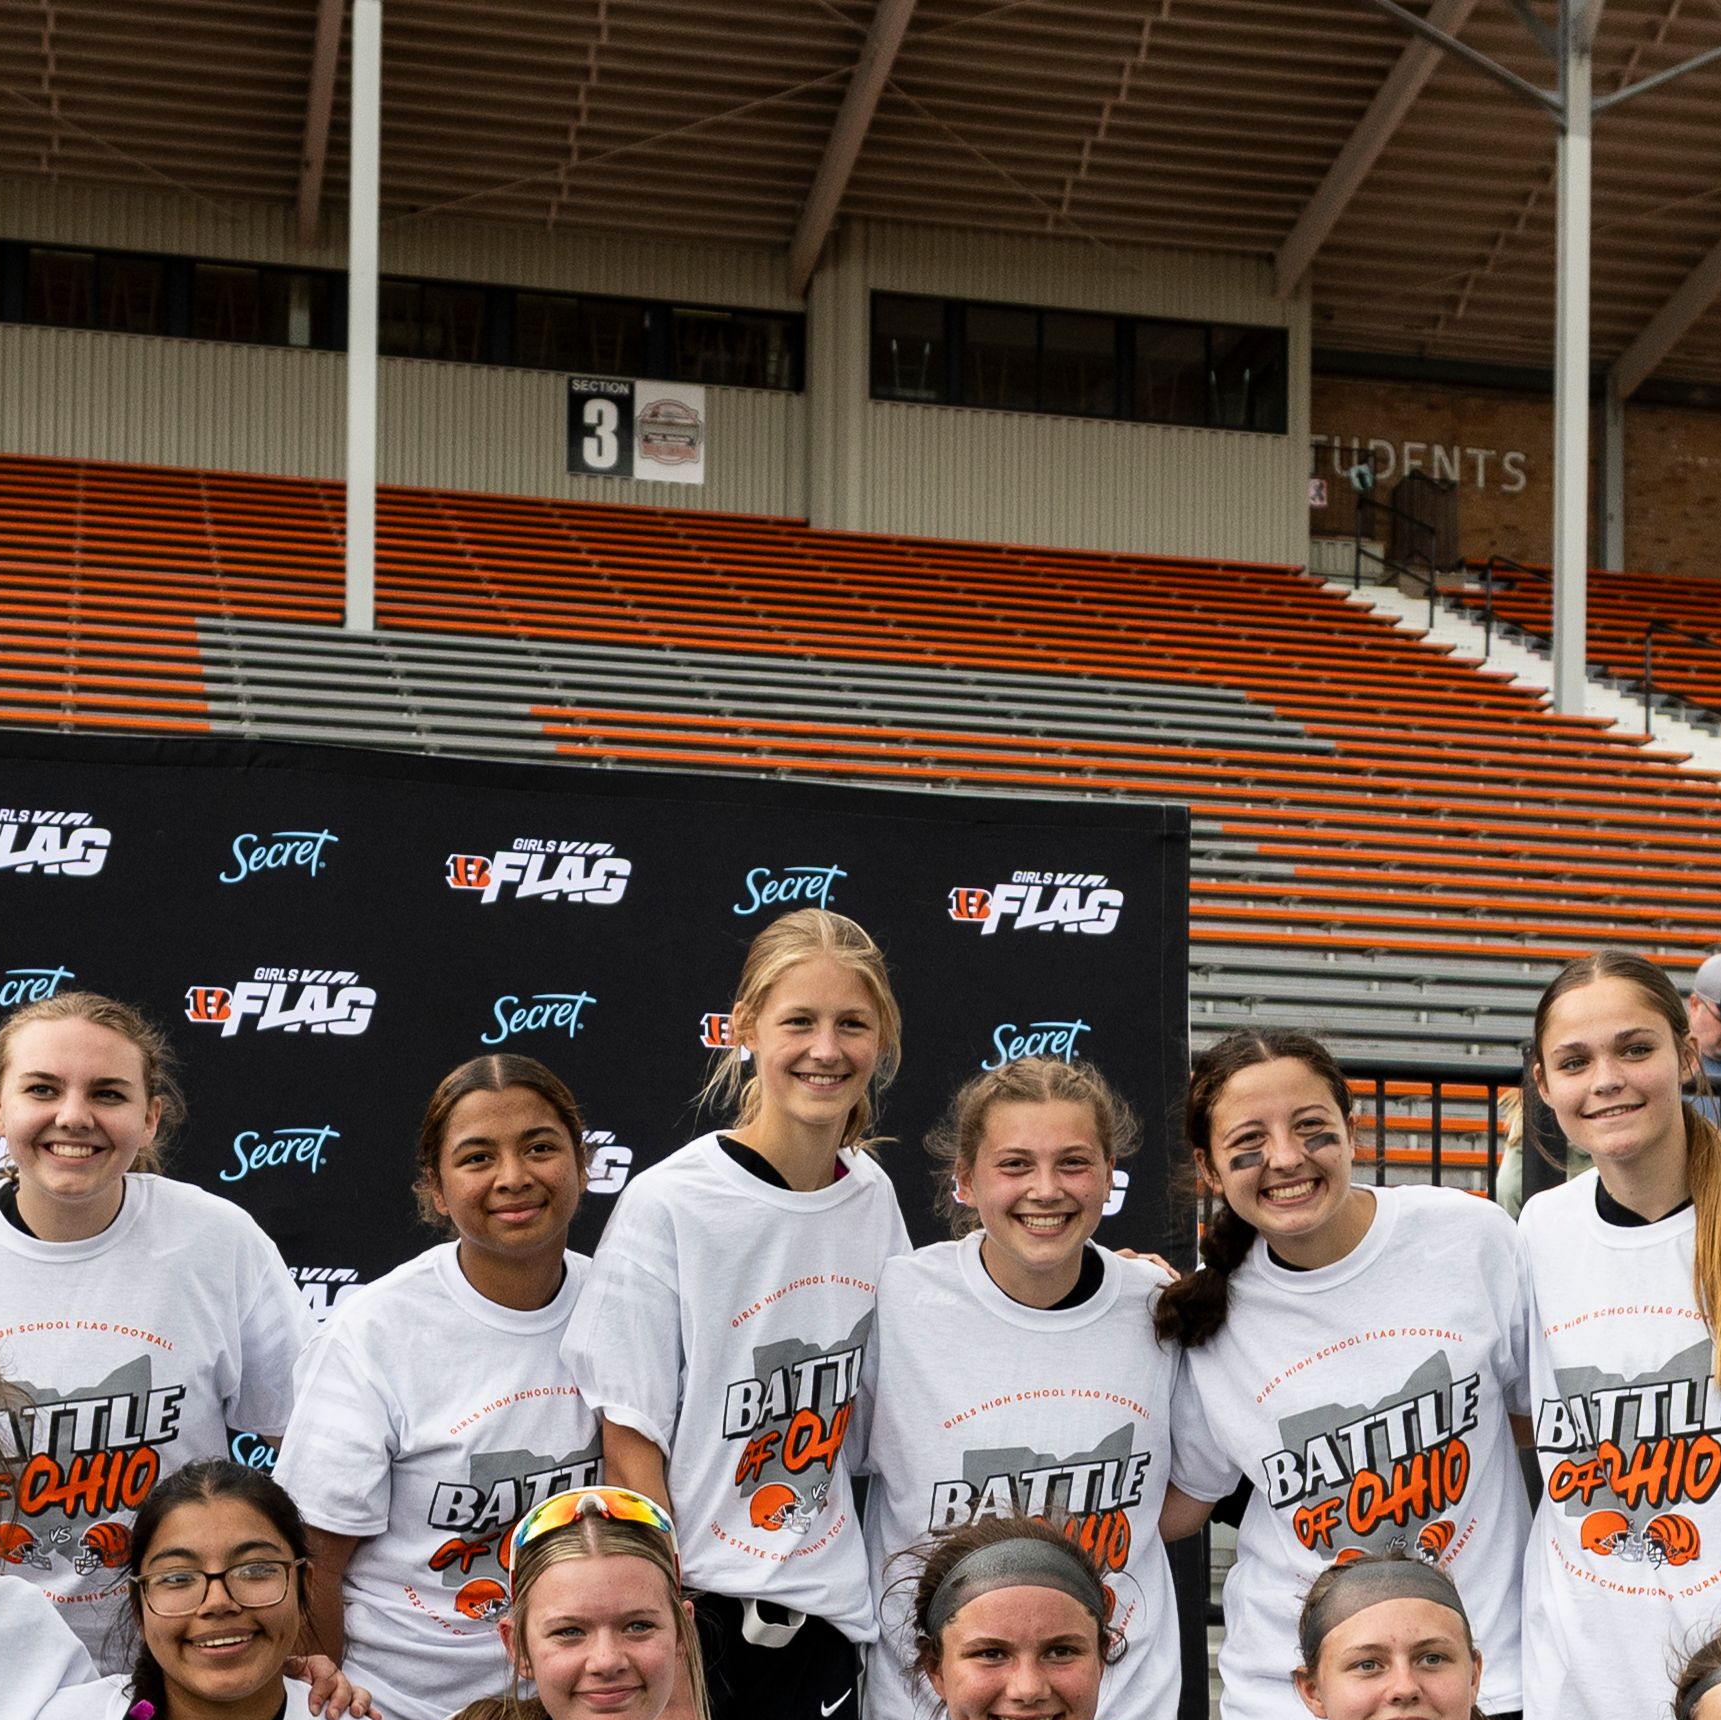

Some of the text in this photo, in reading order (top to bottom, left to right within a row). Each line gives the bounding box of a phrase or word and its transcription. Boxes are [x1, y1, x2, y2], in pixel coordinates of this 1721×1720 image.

[572, 379, 629, 393] SECTION
[583, 398, 618, 468] 3
[219, 829, 338, 883] Secret
[512, 837, 557, 853] GIRLS
[481, 848, 632, 904] FLAG
[733, 864, 847, 916] Secret
[1012, 870, 1054, 885] GIRLS
[981, 882, 1123, 935] FLAG
[254, 967, 298, 982] GIRLS
[221, 981, 376, 1037] FLAG
[481, 990, 597, 1045] Secret
[982, 1019, 1091, 1071] Secret
[220, 1125, 340, 1181] Secret
[1256, 1328, 1463, 1404] GIRLS HIGH SCHOOL FLAG FOOTBALL
[944, 1389, 1151, 1429] GIRLS HIGH SCHOOL FLAG FOOTBALL
[1261, 1371, 1480, 1510] BATTLE
[19, 1445, 160, 1518] OHIO
[928, 1451, 1151, 1534] BATTLE
[1293, 1437, 1470, 1551] OF OHIO
